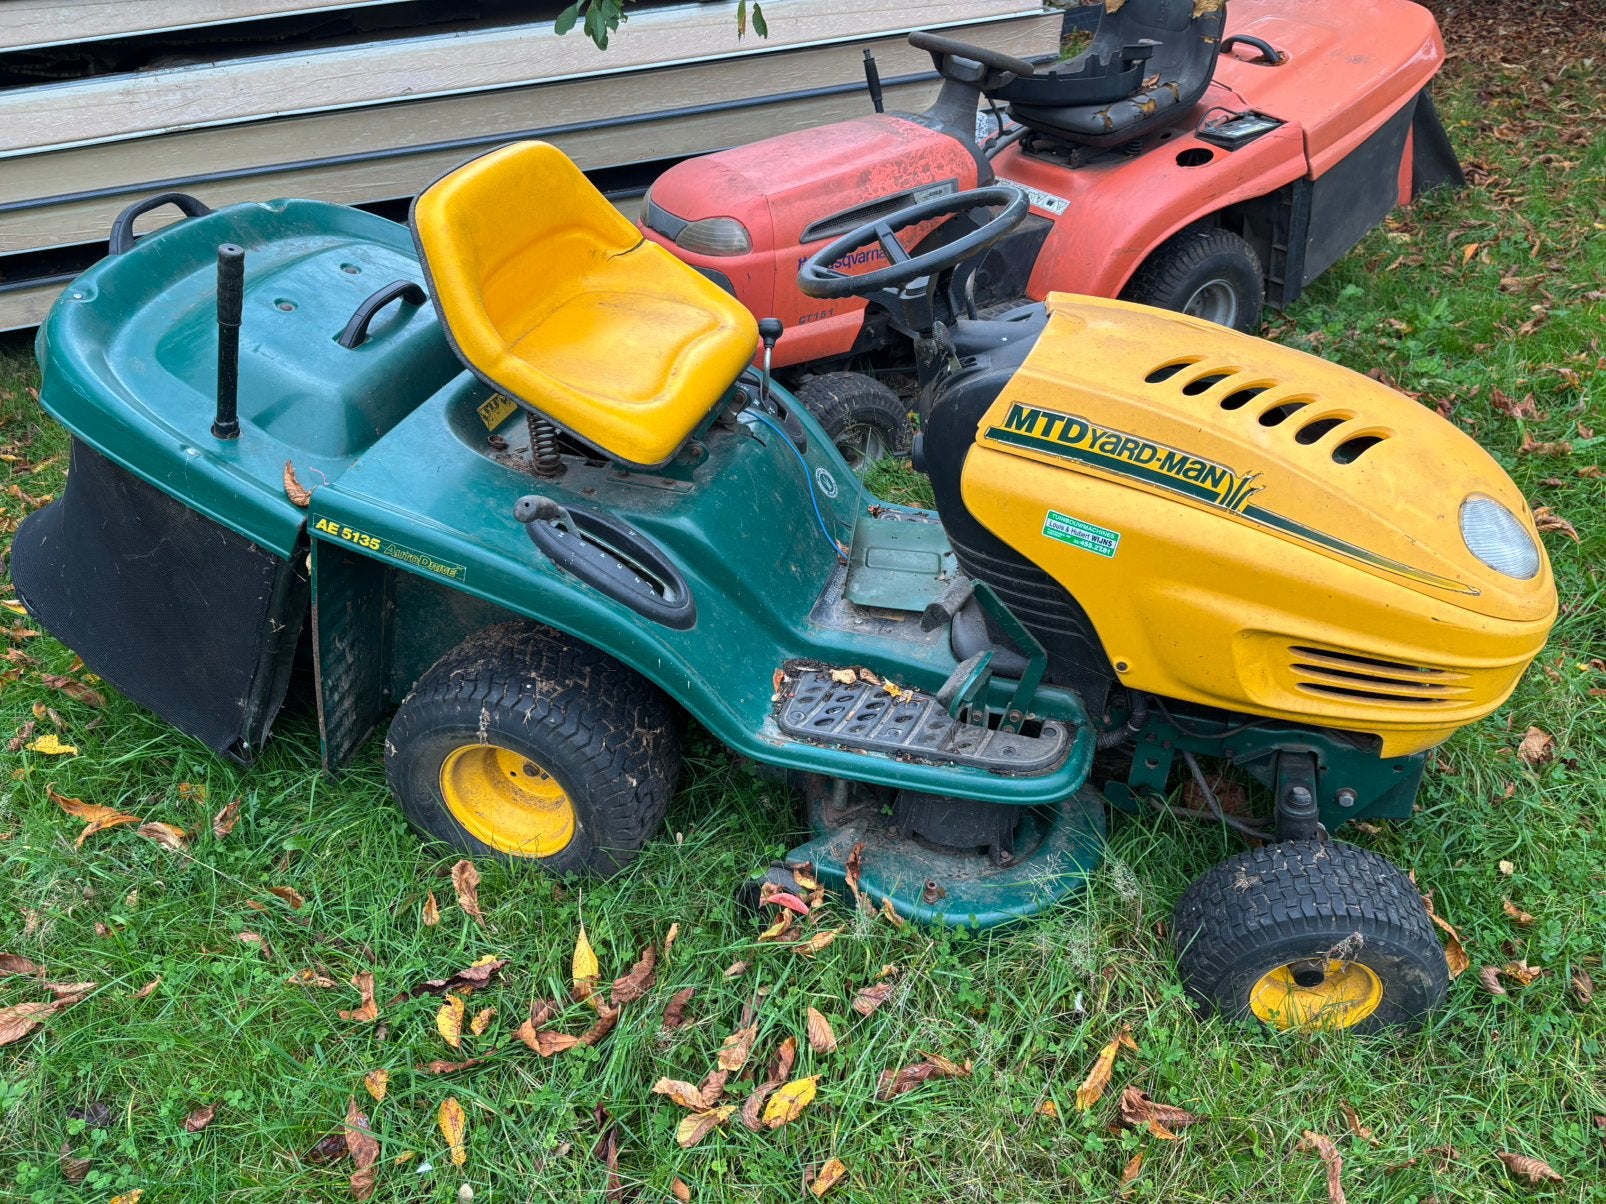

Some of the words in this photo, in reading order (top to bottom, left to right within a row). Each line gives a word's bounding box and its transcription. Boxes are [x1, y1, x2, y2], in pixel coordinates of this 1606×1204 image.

[798, 248, 887, 271] Hsqvarna
[1004, 403, 1089, 444] MTD
[315, 518, 340, 536] AE
[341, 527, 381, 551] 5135
[1049, 520, 1065, 531] Louis
[1071, 528, 1090, 540] Hubert
[1091, 535, 1113, 547] WIJNS
[1052, 513, 1115, 538] TUINBOUWMACHINES
